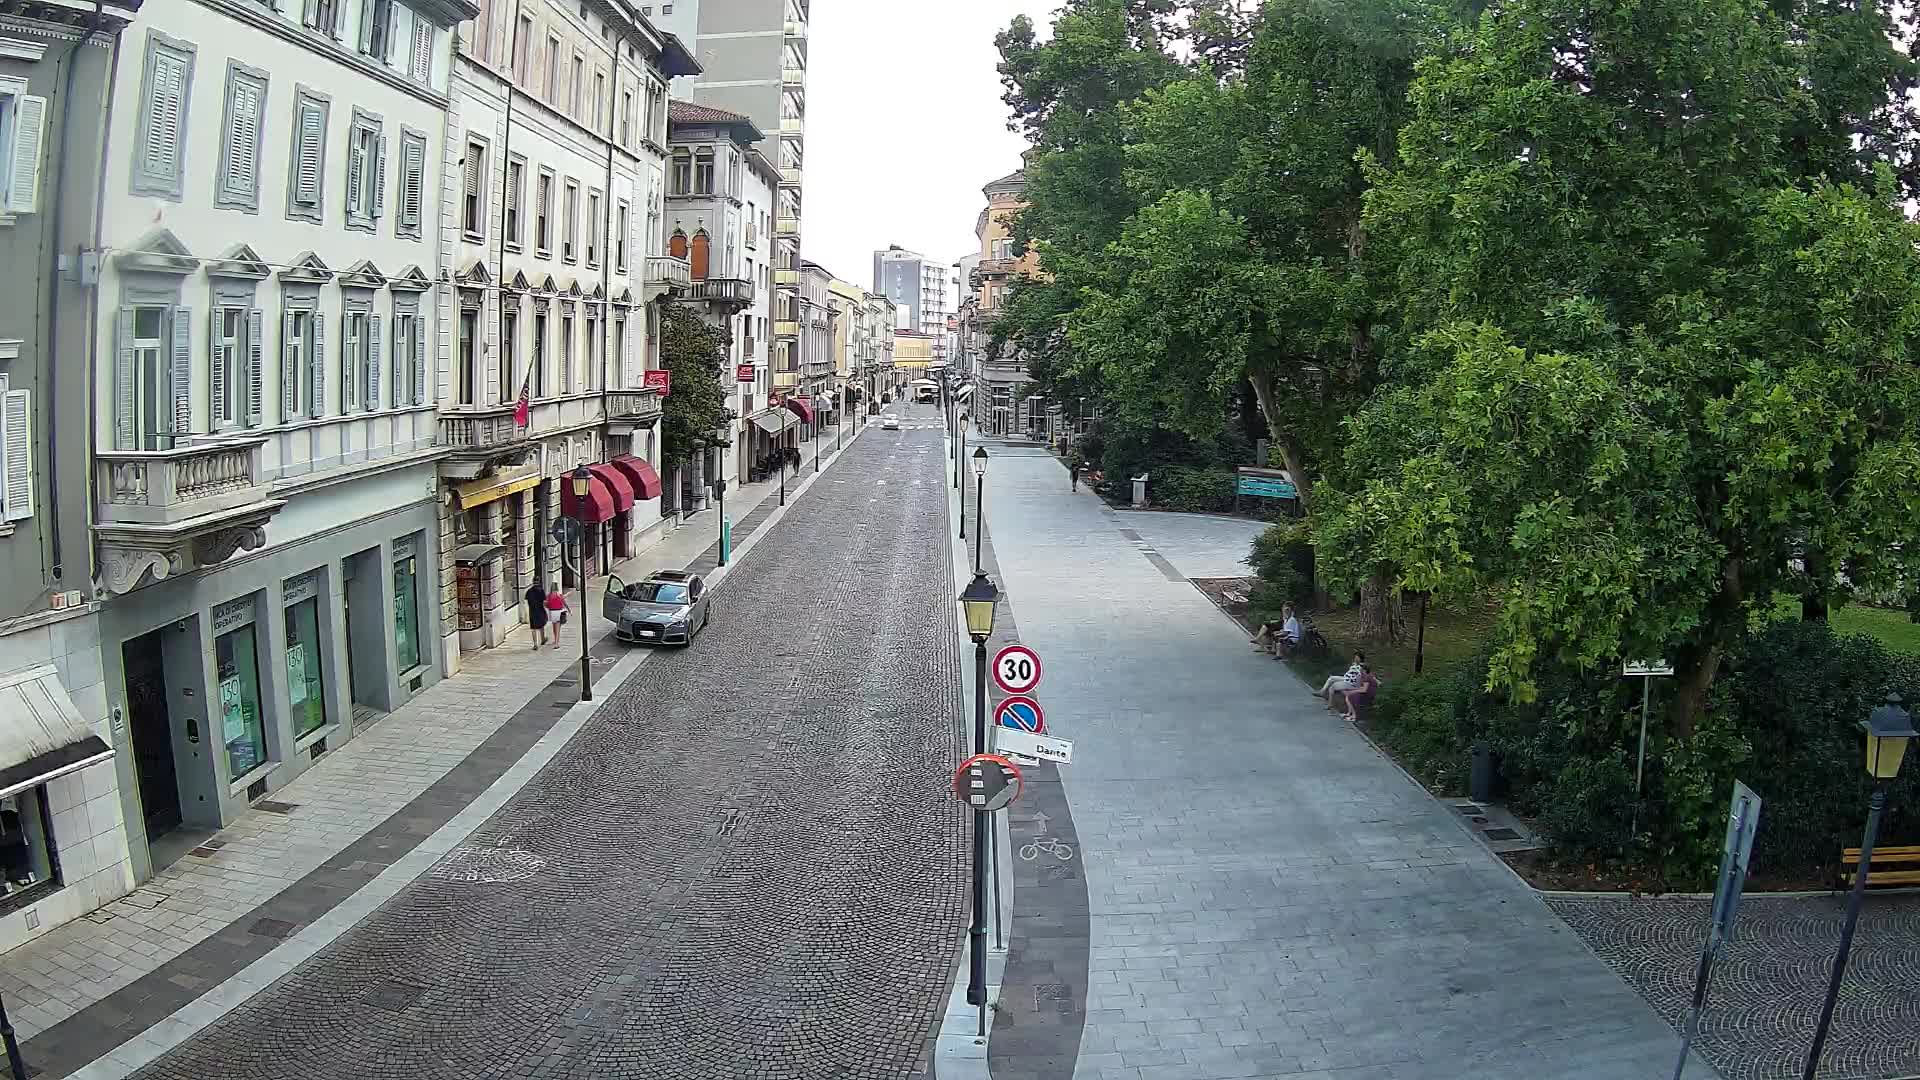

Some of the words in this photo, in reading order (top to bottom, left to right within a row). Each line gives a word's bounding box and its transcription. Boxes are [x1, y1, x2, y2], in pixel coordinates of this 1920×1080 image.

[215, 613, 243, 629] OPERATIVO
[1005, 659, 1031, 680] 30
[1036, 744, 1066, 758] Dante
